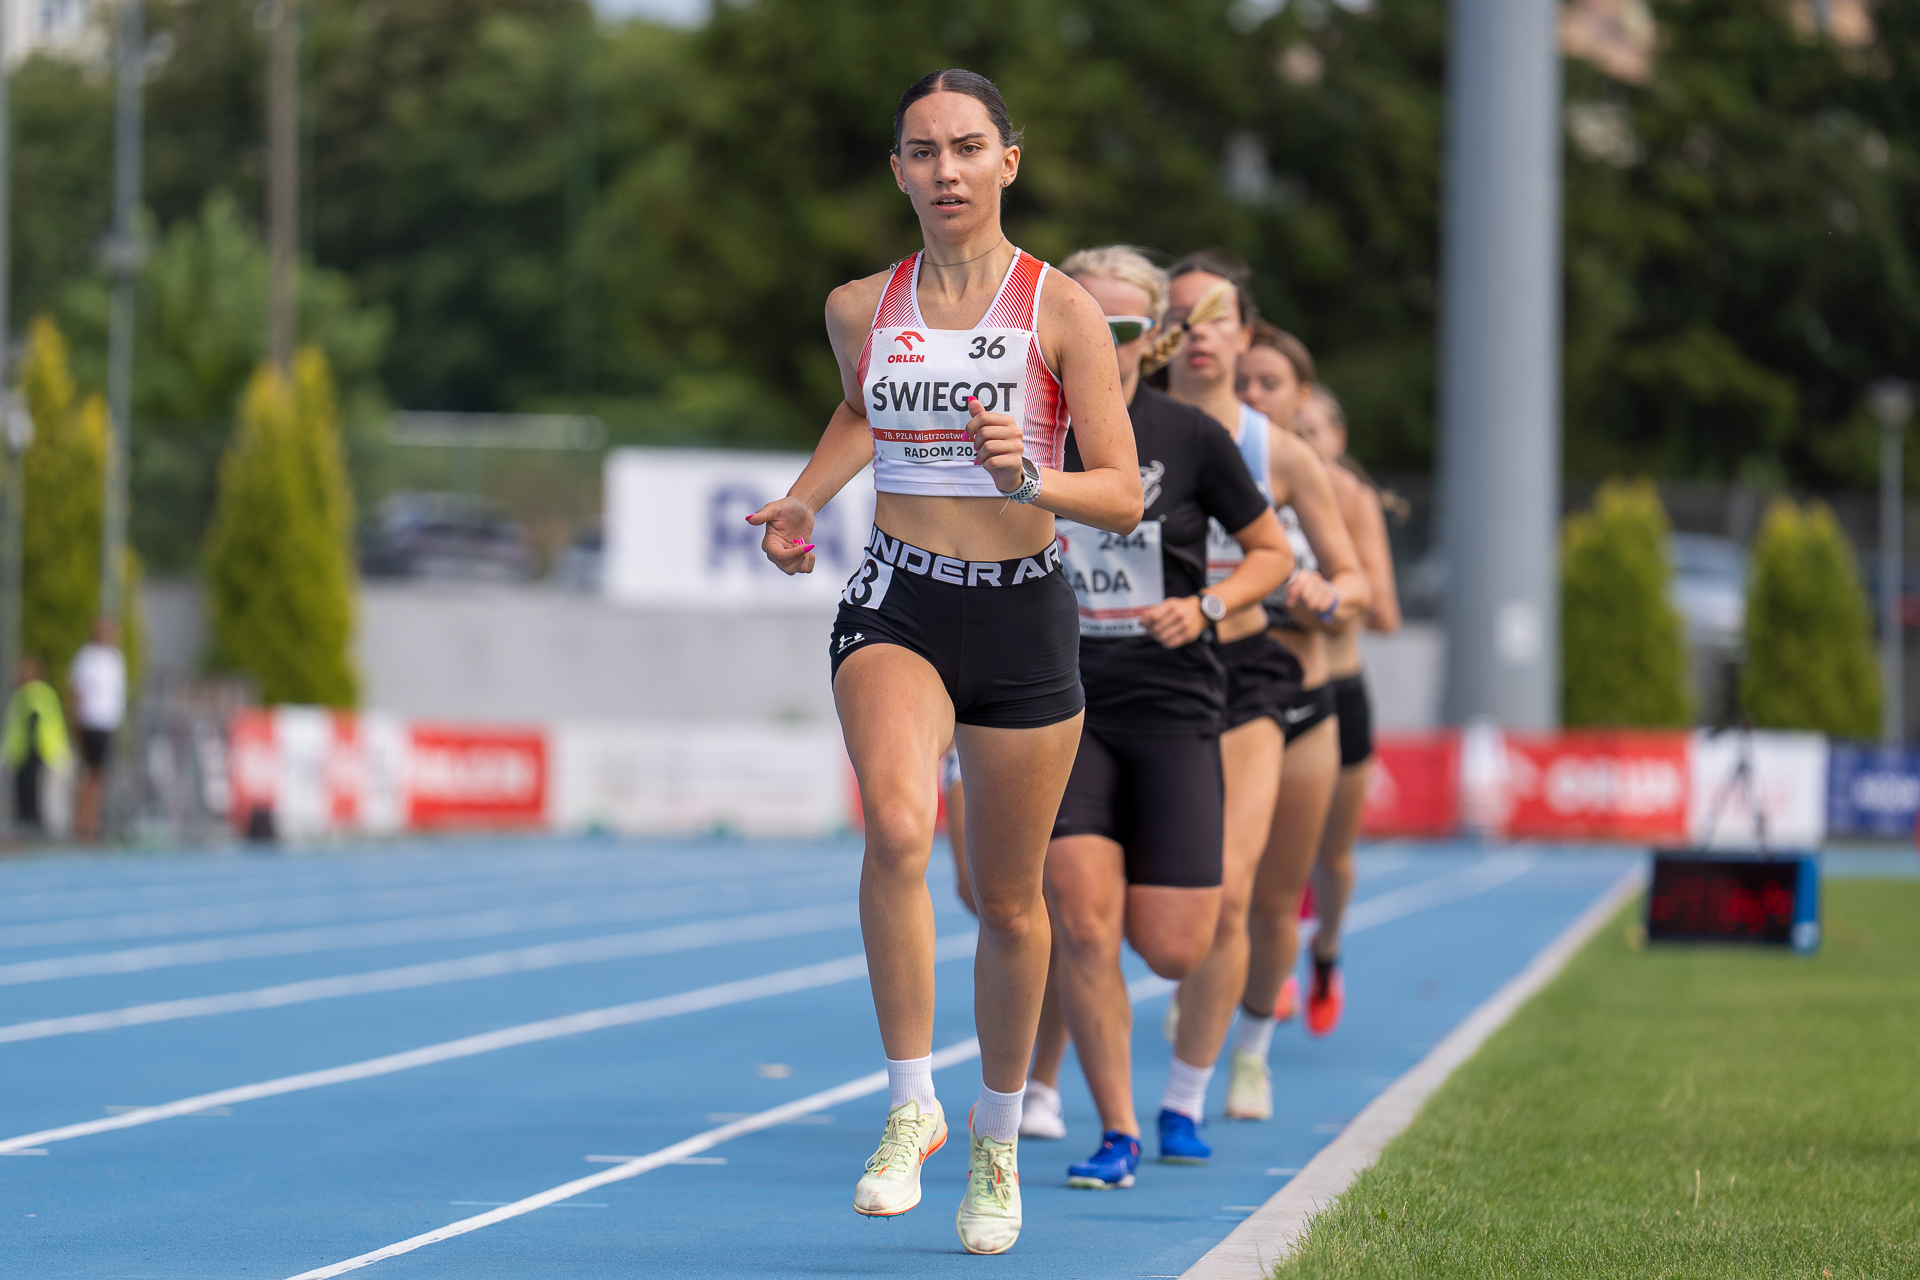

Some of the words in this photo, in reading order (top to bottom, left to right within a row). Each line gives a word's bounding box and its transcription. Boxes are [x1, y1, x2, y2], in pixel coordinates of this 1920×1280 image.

[887, 354, 925, 363] ORLEN
[968, 335, 1006, 359] 36
[871, 375, 1018, 412] ŚWIEGOT
[883, 431, 895, 440] 78.
[896, 432, 913, 440] PZLA
[904, 446, 953, 458] RADOM
[1098, 529, 1147, 550] 244
[869, 525, 1003, 587] NDER
[850, 558, 879, 606] 3
[1063, 567, 1132, 593] ADA
